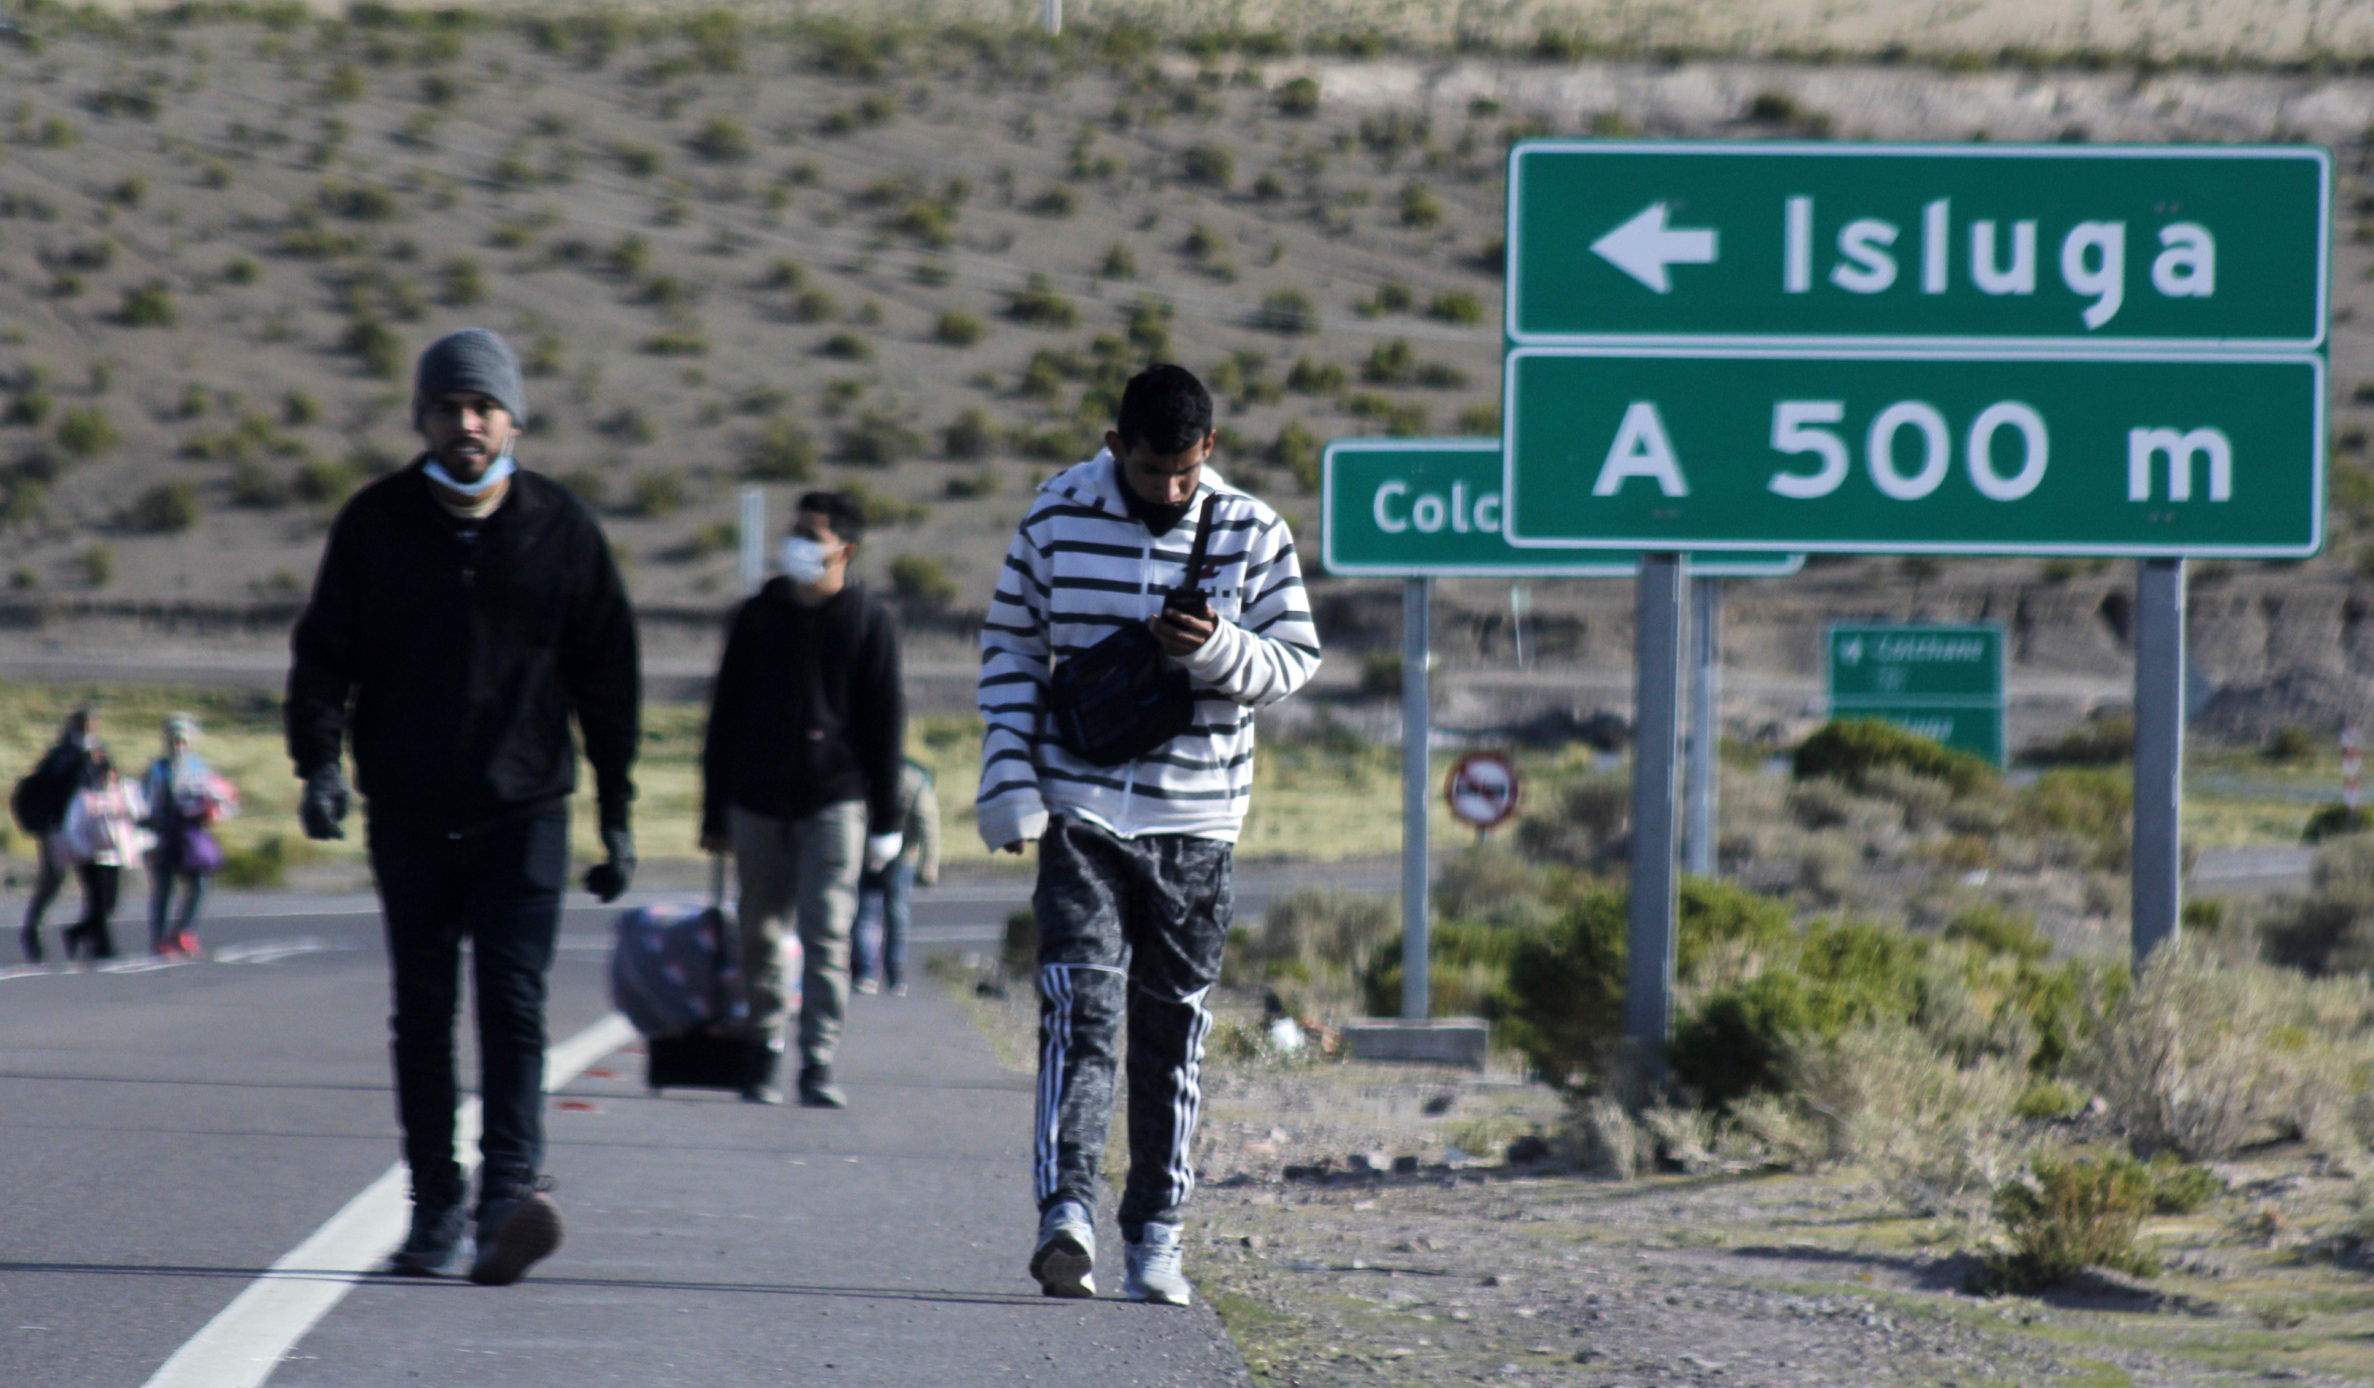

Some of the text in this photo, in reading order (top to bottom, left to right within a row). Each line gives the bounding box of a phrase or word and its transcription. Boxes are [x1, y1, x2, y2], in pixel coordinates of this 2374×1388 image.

[1785, 197, 2216, 329] Isluga
[1593, 401, 2232, 501] A 500 m
